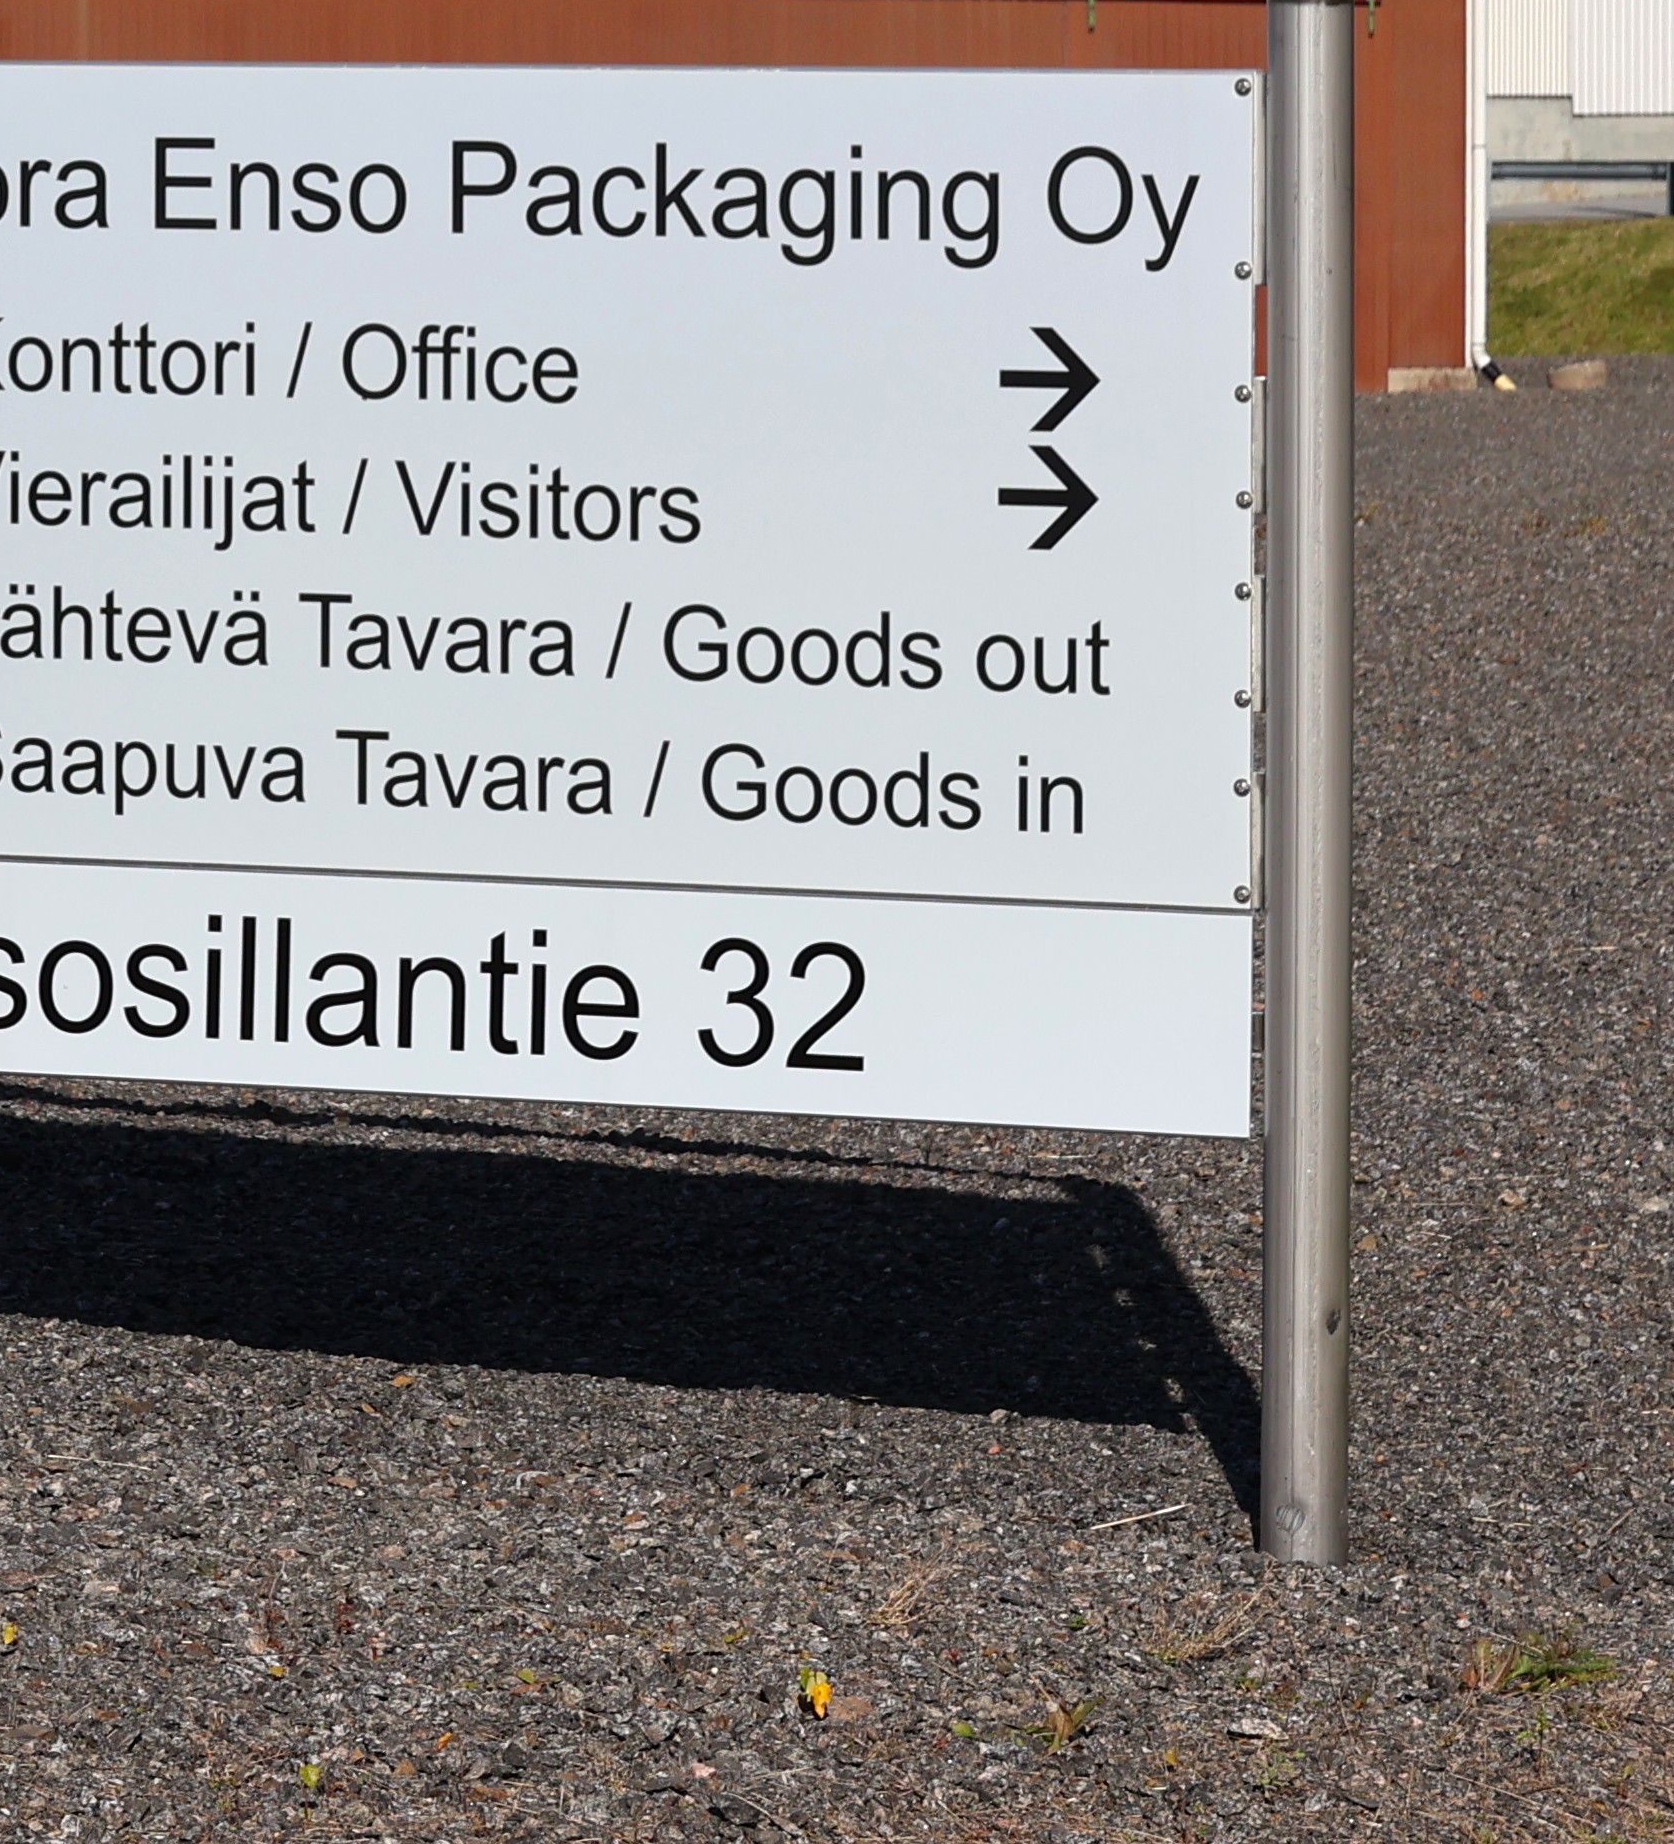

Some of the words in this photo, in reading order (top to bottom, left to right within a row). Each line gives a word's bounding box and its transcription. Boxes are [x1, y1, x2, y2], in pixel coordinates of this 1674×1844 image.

[154, 137, 407, 234] Enso
[452, 140, 999, 269] Packaging
[1047, 145, 1200, 272] Oy
[286, 321, 312, 399] /
[342, 323, 579, 404] Office
[342, 458, 368, 535] /
[395, 460, 701, 544] Visitors
[298, 592, 575, 677] Tavara
[605, 601, 632, 679] /
[663, 604, 943, 690] Goods
[976, 620, 1111, 696] out
[335, 729, 612, 815] Tavara
[643, 740, 670, 818] /
[701, 743, 982, 831] Goods
[1018, 755, 1083, 834] in
[698, 937, 866, 1072] 32
